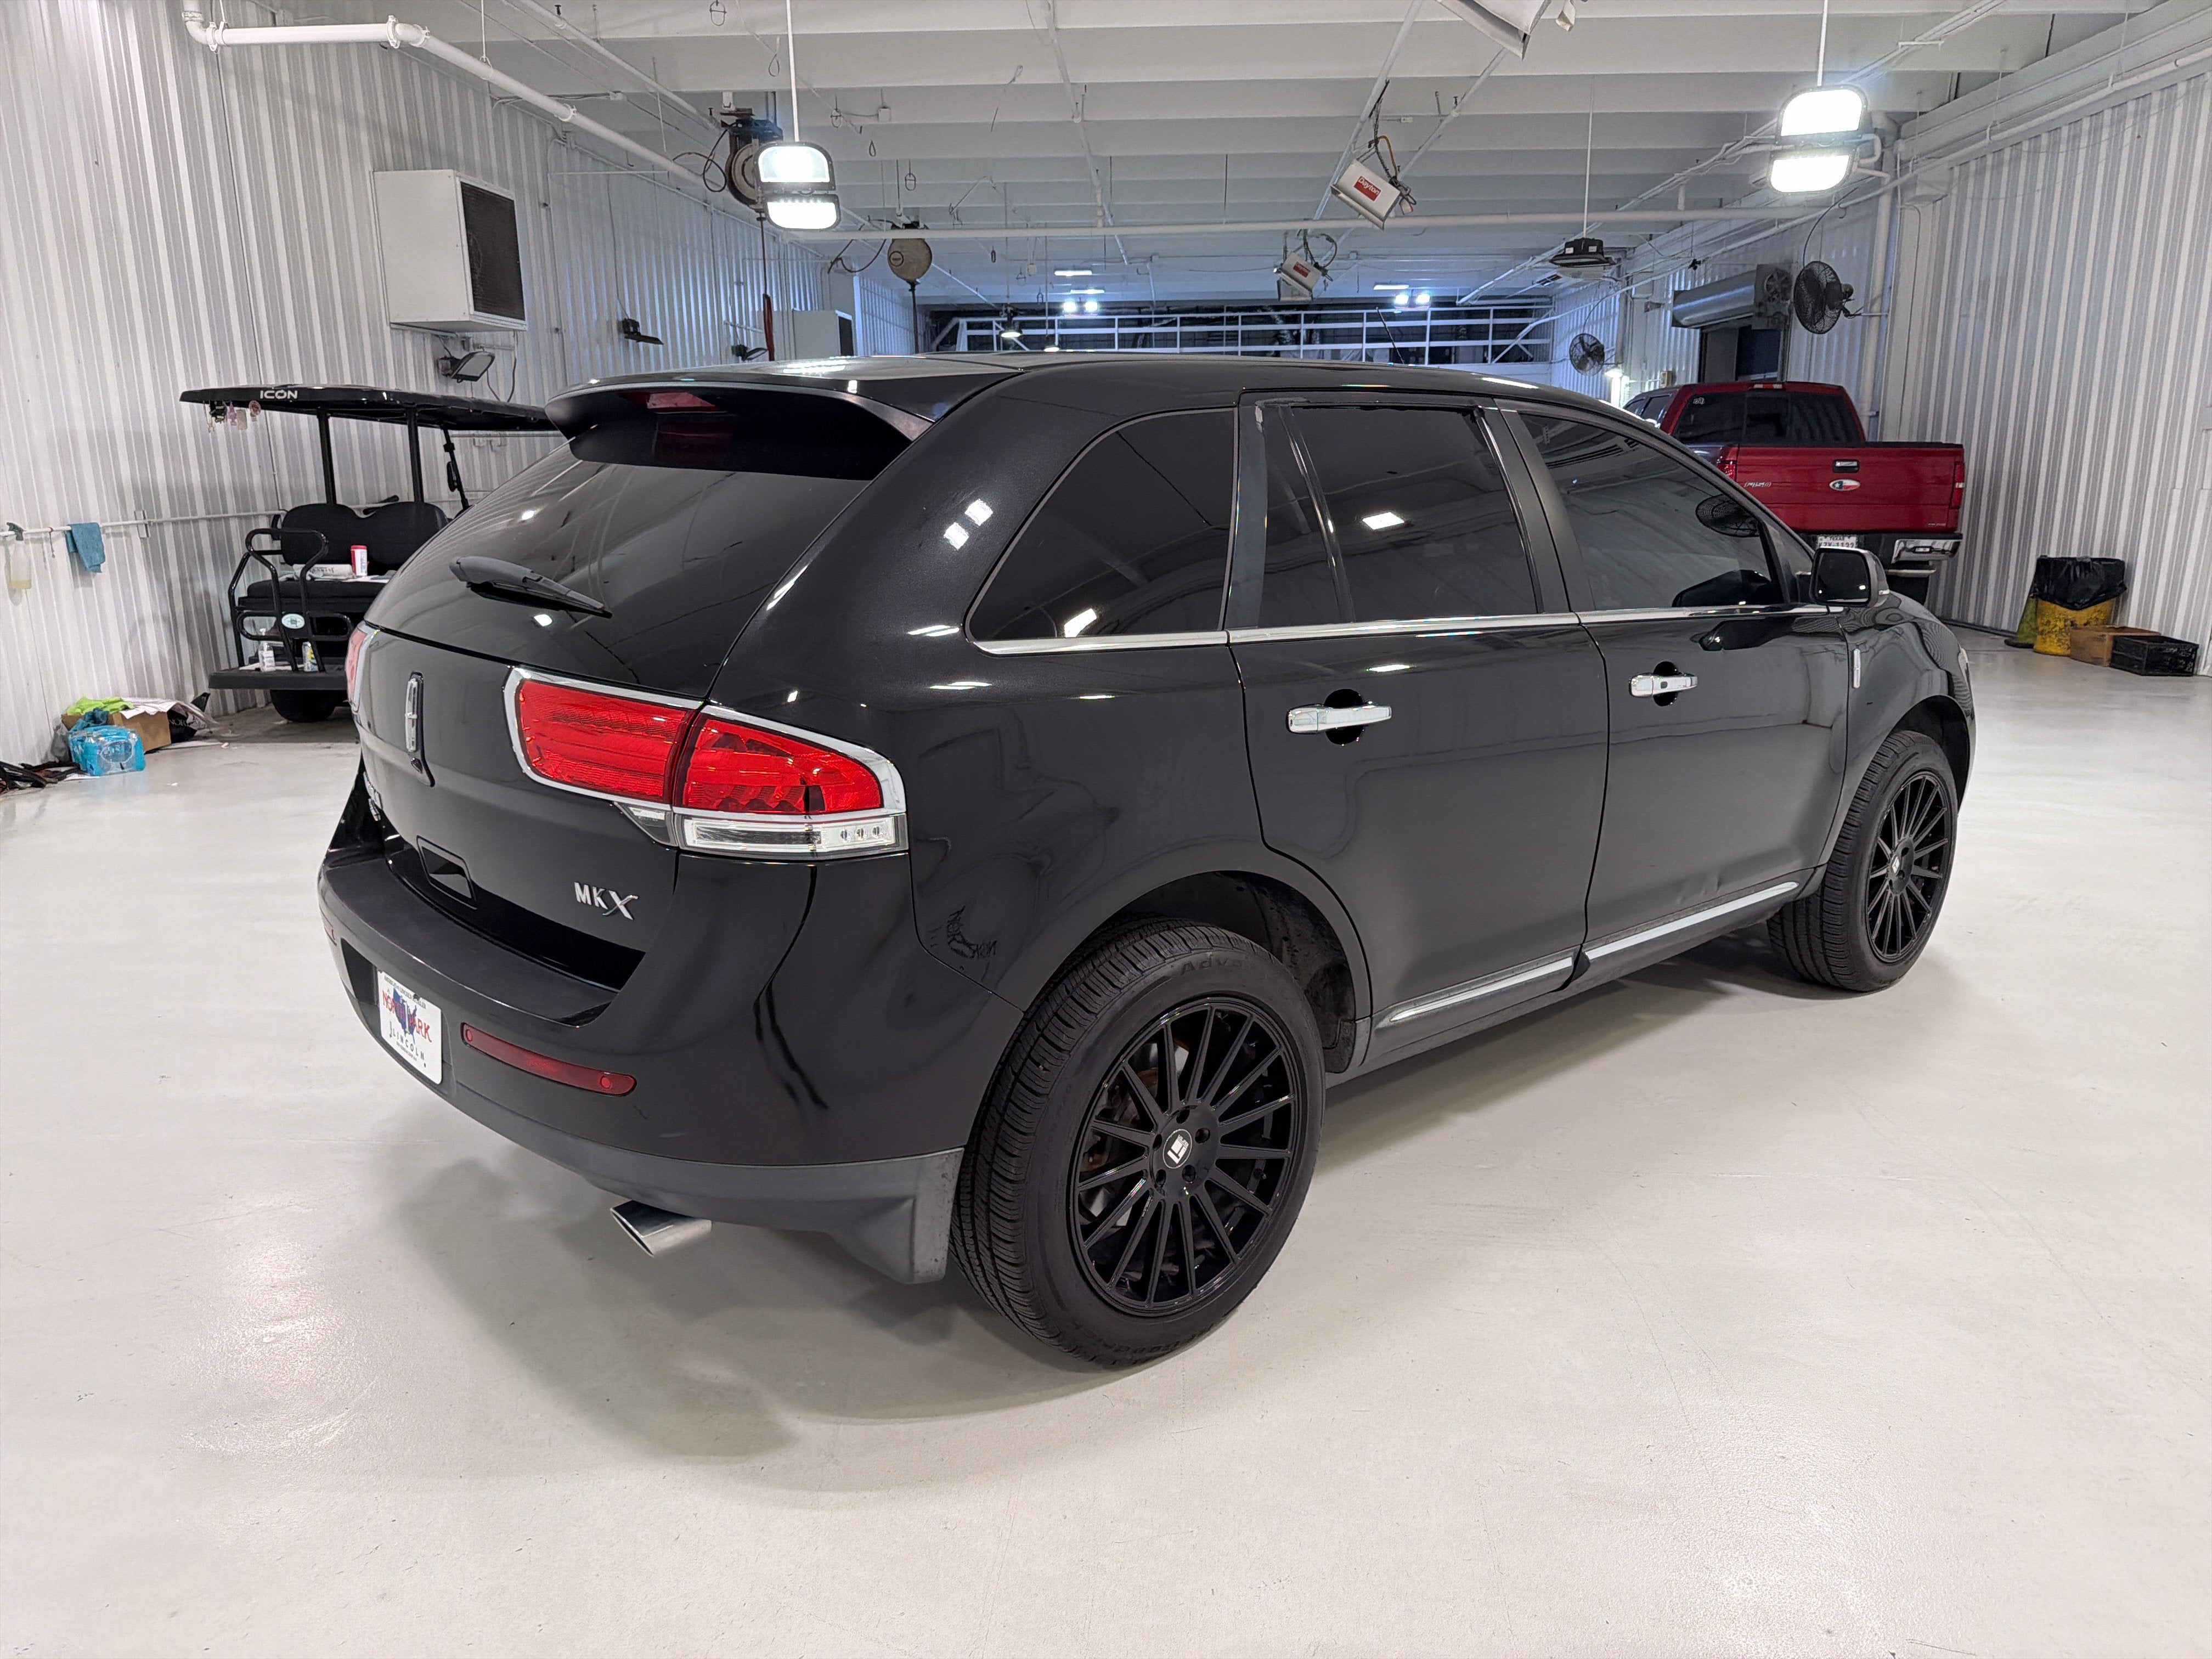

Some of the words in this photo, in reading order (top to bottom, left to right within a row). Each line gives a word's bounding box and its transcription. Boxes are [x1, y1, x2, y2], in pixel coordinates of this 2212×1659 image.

[1358, 177, 1380, 196] Dayton
[259, 390, 298, 399] ICON
[574, 882, 639, 921] MKX
[393, 1028, 425, 1060] LINCOLN
